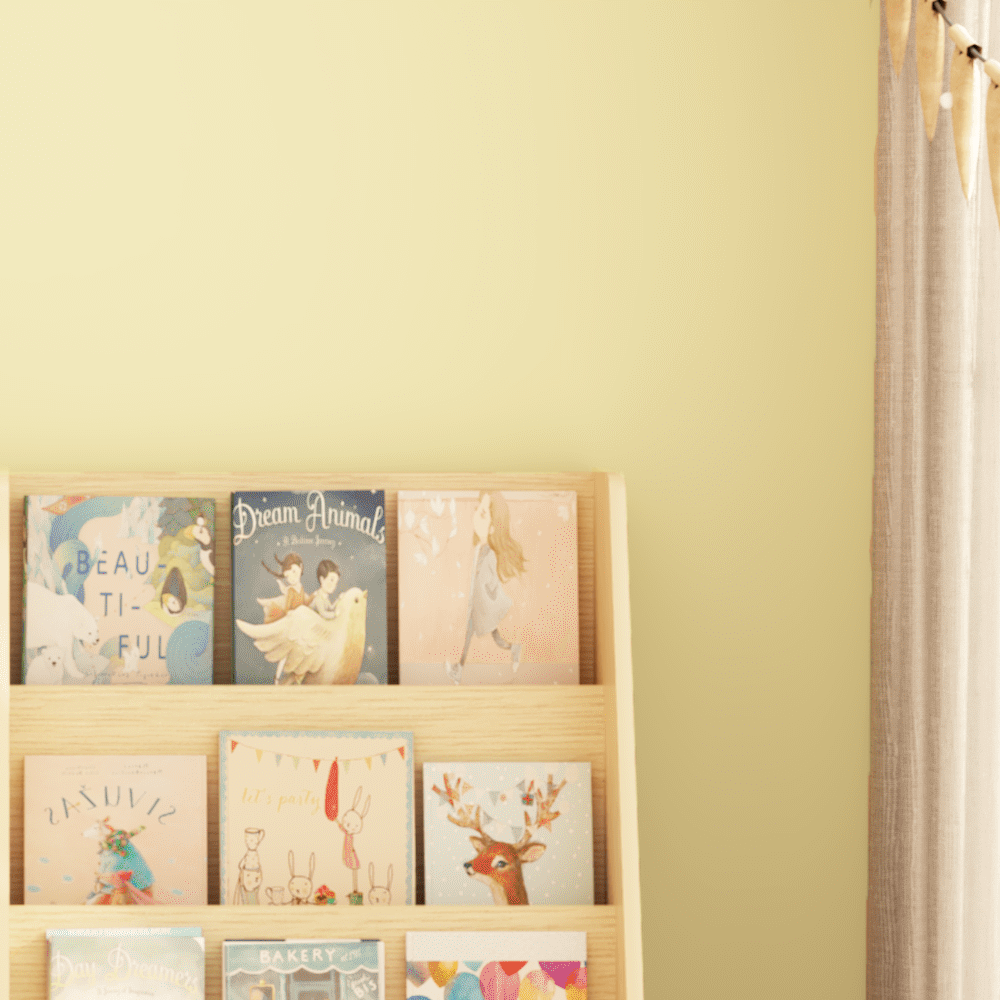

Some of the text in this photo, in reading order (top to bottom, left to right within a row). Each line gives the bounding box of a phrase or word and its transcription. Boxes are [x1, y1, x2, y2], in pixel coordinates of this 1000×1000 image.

[233, 489, 386, 546] Dream Animals
[76, 549, 167, 576] BEAU-
[99, 592, 141, 618] TI-
[118, 633, 167, 660] FUL
[276, 789, 322, 816] party
[50, 942, 200, 995] Day Dreamers
[259, 947, 336, 964] BAKERY
